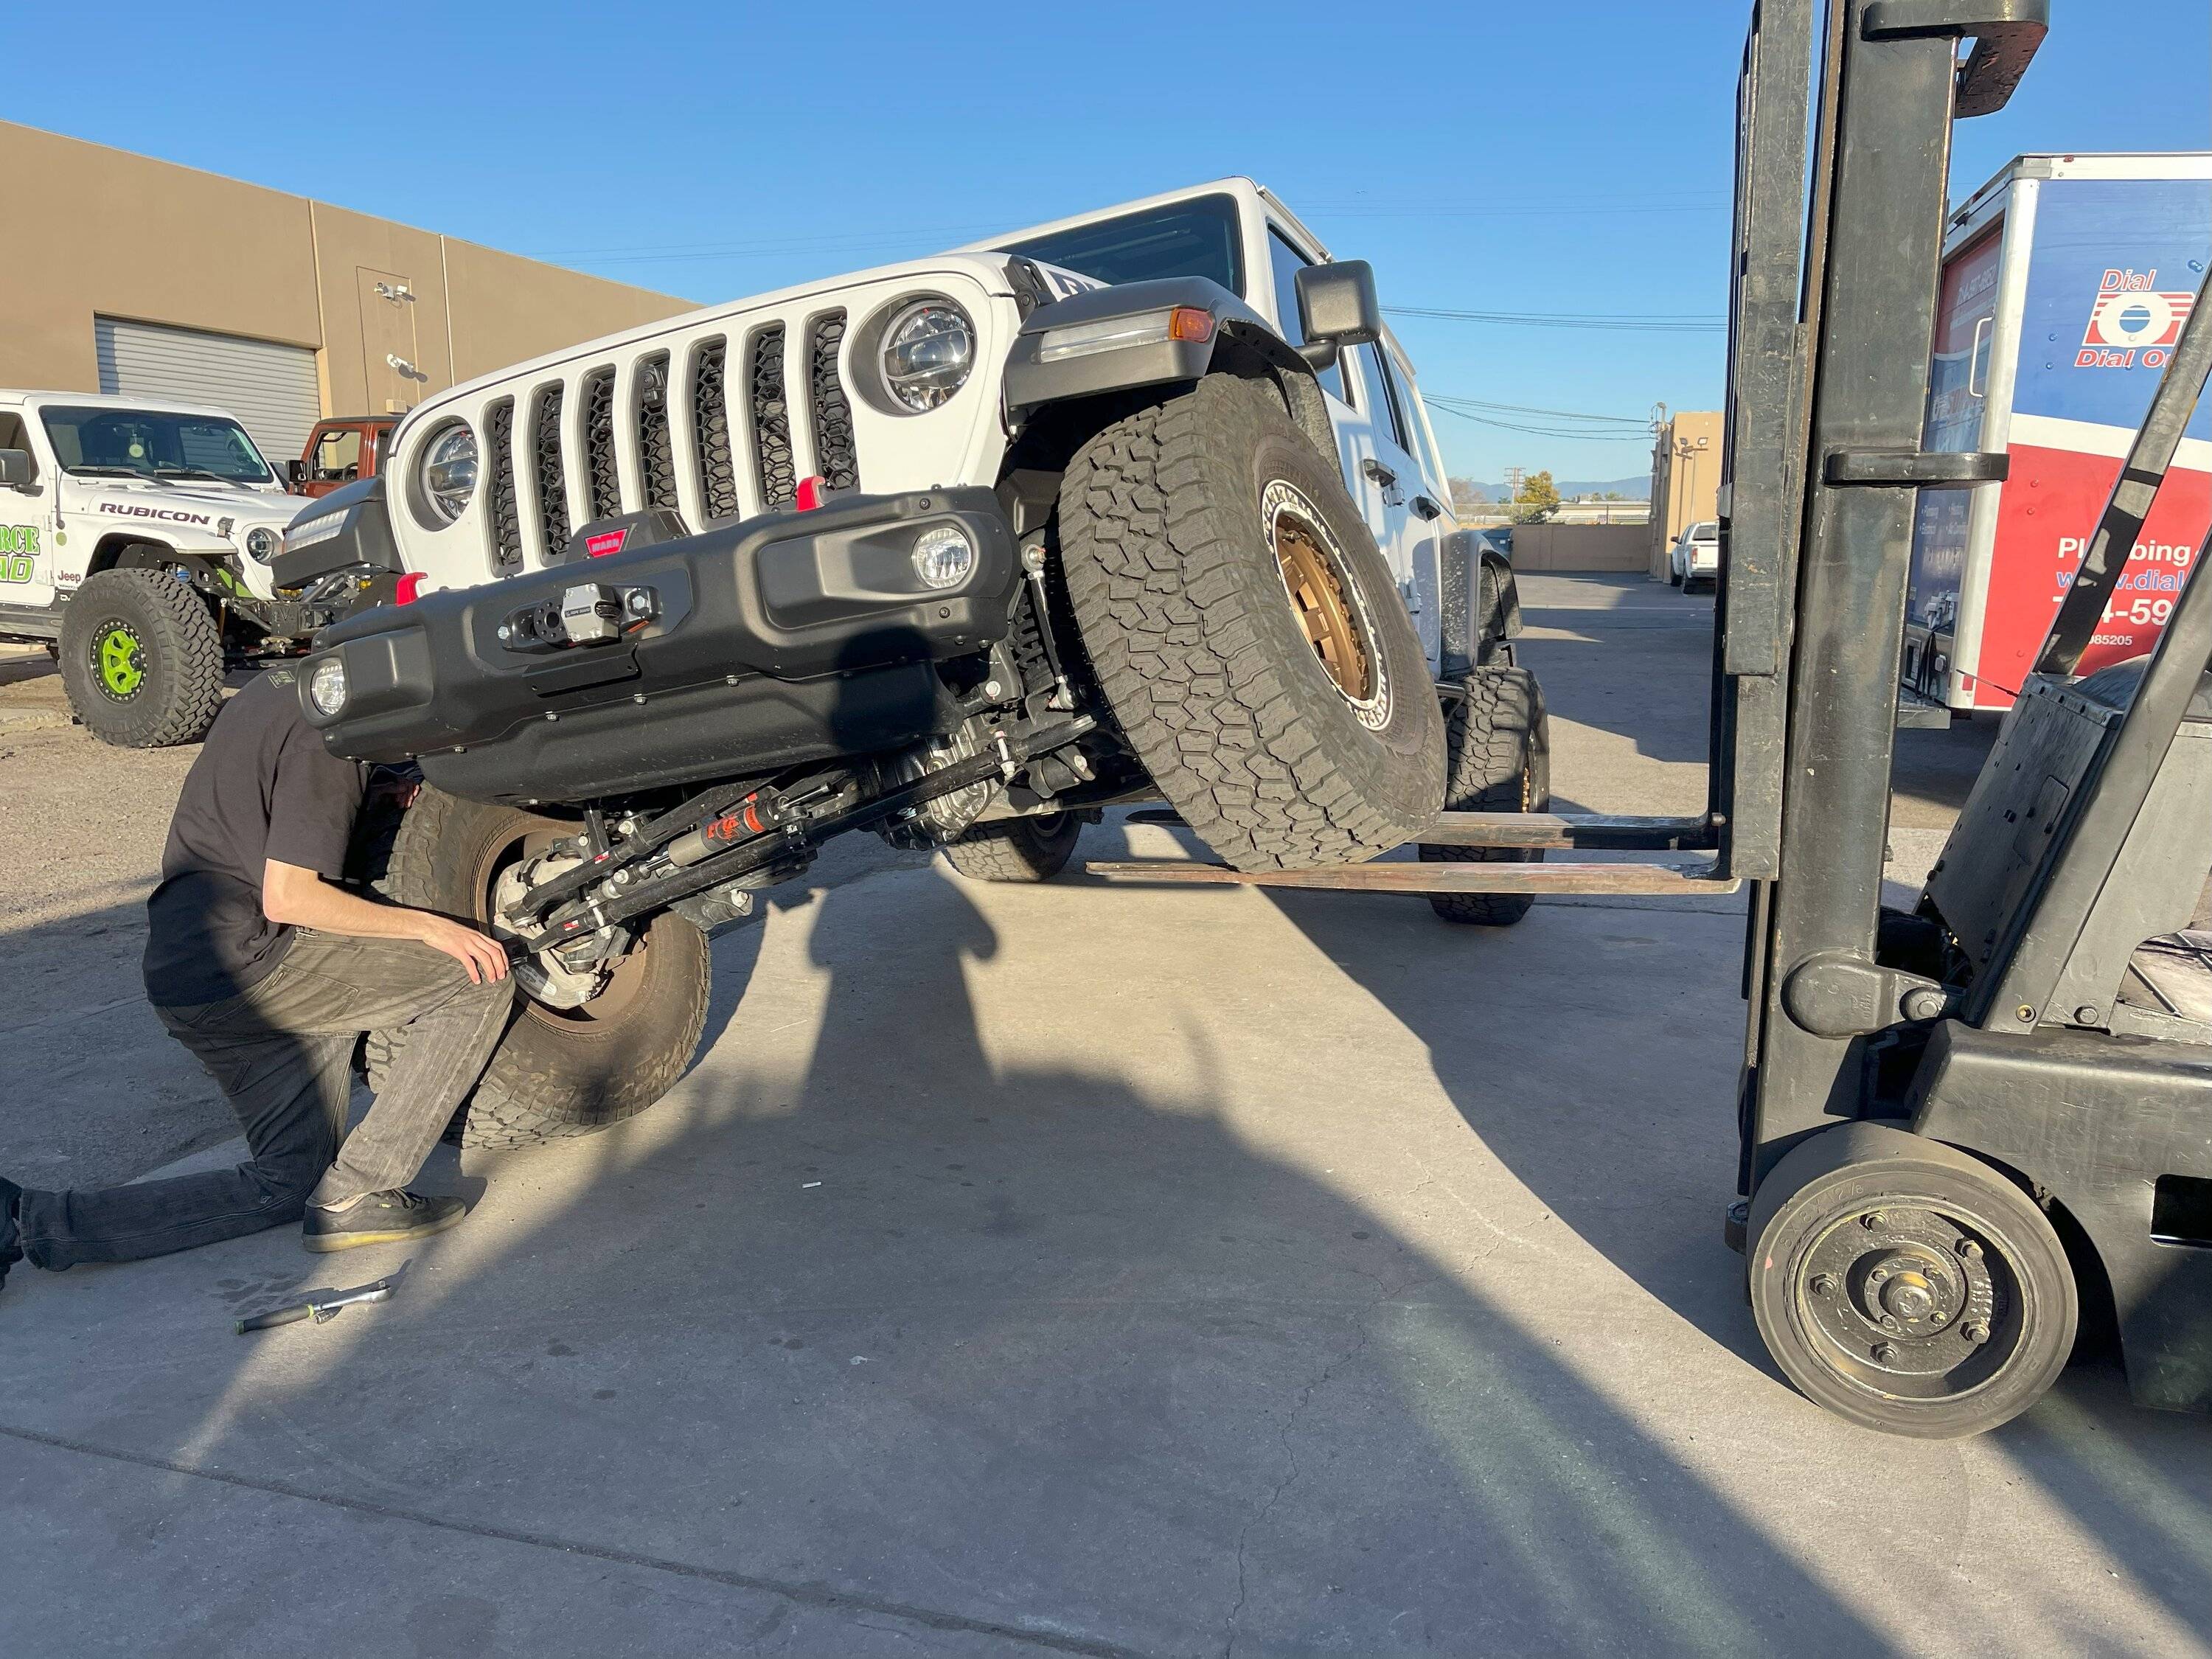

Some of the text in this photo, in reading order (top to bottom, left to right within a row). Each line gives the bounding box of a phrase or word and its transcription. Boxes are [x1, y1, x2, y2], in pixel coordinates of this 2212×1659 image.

[2099, 269, 2157, 291] Dial
[2074, 349, 2136, 368] Dial
[100, 503, 211, 525] RUBICON
[2058, 537, 2191, 567] Plbing
[58, 570, 81, 583] Jeep
[2056, 568, 2185, 592] ww.dial
[2053, 596, 2173, 626] 4-59
